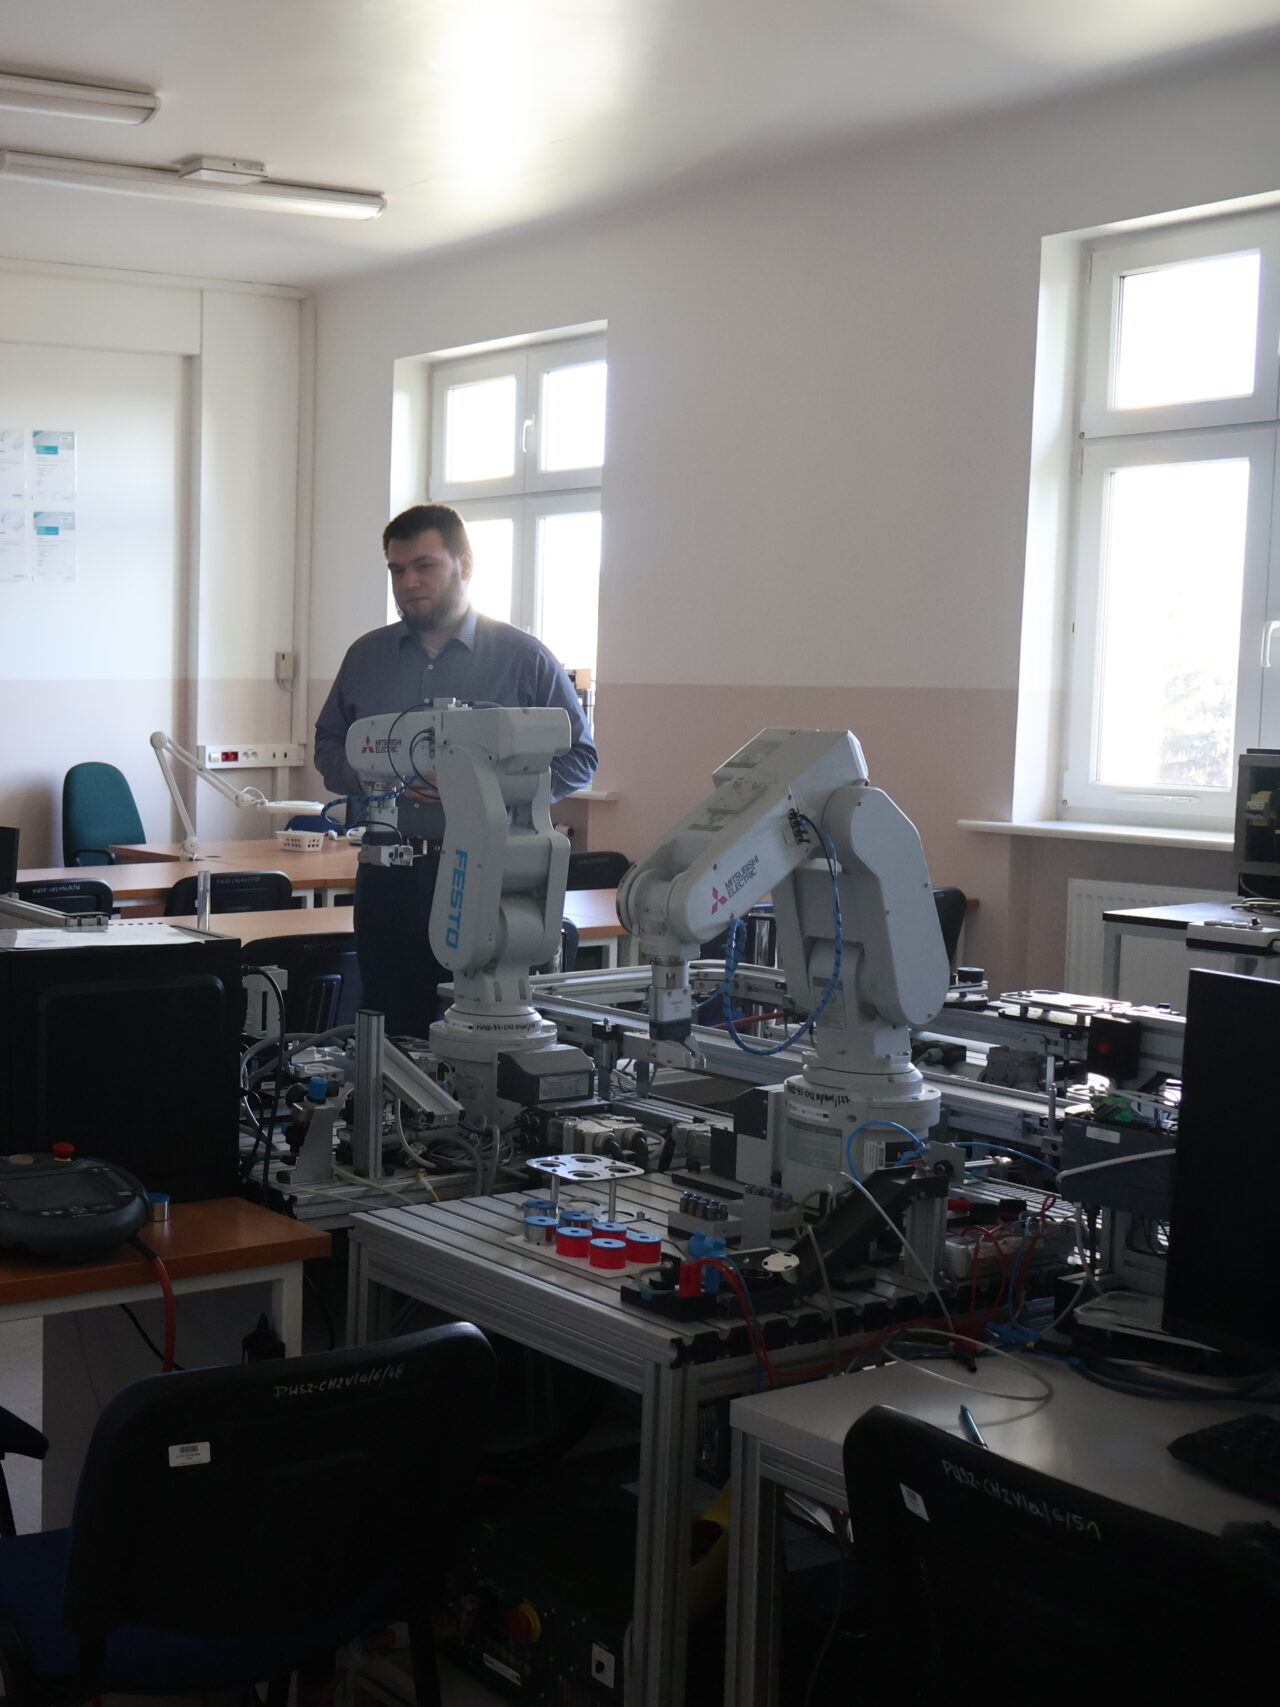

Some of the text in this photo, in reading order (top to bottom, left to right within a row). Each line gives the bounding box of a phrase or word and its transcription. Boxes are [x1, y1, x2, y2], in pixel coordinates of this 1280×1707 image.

[725, 854, 759, 890] MITSUBISHI
[727, 866, 757, 898] ELECTRIC
[445, 849, 468, 949] FESTO
